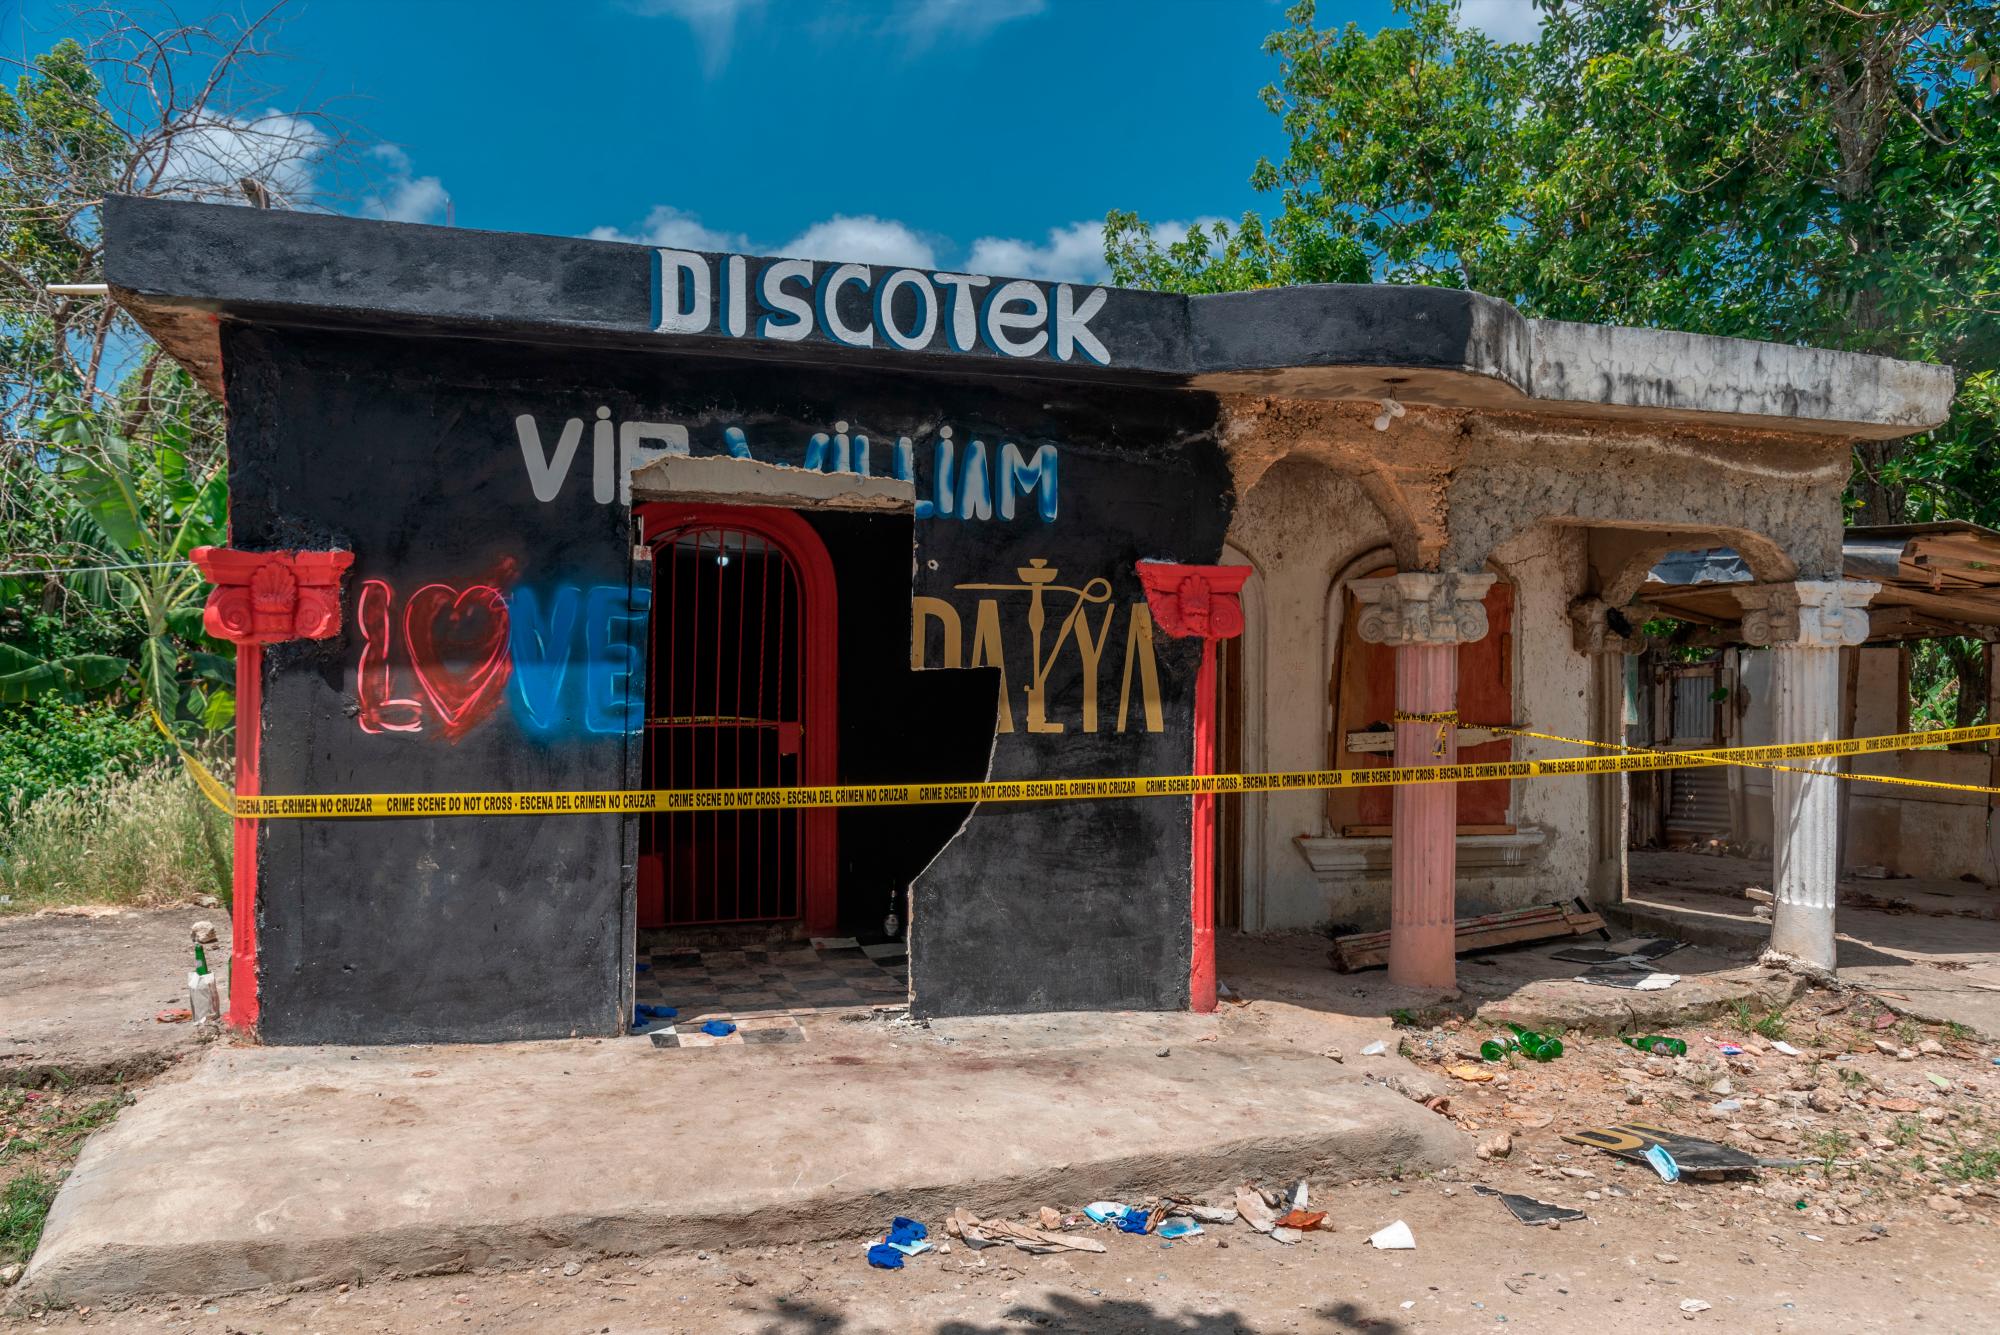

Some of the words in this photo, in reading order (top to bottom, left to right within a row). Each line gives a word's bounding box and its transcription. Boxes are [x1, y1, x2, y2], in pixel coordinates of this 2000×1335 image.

[1866, 740, 1879, 750] CRIME
[1880, 738, 1893, 749] SCENE
[1894, 737, 1900, 747] DO
[1901, 736, 1909, 747] NOT
[1910, 734, 1924, 746] CROSS
[1926, 733, 1942, 744] ESCENA
[1943, 731, 1951, 742] DEL
[1951, 730, 1966, 741] CRIMEN
[1967, 729, 1974, 740] NO
[1974, 728, 1991, 739] CRUZAR
[1729, 750, 1745, 762] SCENE
[1746, 749, 1754, 761] DO
[1755, 748, 1765, 761] NOT
[1766, 747, 1783, 760] CROSS
[1786, 745, 1805, 757] ESCENA
[1806, 744, 1816, 756] DEL
[1817, 743, 1835, 755] CRIMEN
[1835, 743, 1842, 753] NO
[1843, 740, 1860, 753] CRUZAR
[1351, 771, 1370, 784] CRIME
[1371, 770, 1391, 783] SCENE
[1392, 770, 1401, 782] DO
[1402, 769, 1414, 782] NOT
[1415, 768, 1435, 781] CROSS
[1439, 767, 1462, 780] ESCENA
[1463, 766, 1475, 778] DEL
[1476, 765, 1498, 778] CRIMEN
[1499, 764, 1507, 776] NO
[1508, 763, 1531, 776] CRUZAR
[1539, 761, 1556, 774] CRIME
[1557, 760, 1576, 773] SCENE
[1576, 759, 1585, 772] DO
[1586, 759, 1597, 771] NOT
[1598, 757, 1616, 770] CROSS
[1620, 756, 1641, 769] ESCENA
[1642, 755, 1653, 768] DEL
[1653, 753, 1674, 767] CRIMEN
[1674, 753, 1683, 766] NO
[919, 787, 942, 800] CRIME
[944, 787, 967, 800] SCENE
[969, 786, 980, 799] DO
[981, 786, 996, 799] NOT
[997, 785, 1020, 798] CROSS
[1026, 784, 1054, 796] ESCENA
[1055, 783, 1068, 796] DEL
[1069, 783, 1095, 796] CRIMEN
[1097, 782, 1107, 794] NO
[1109, 781, 1136, 794] CRUZAR
[1146, 780, 1166, 793] CRIME
[1168, 779, 1189, 792] SCENE
[1191, 779, 1200, 791] DO
[1202, 778, 1215, 791] NOT
[1216, 777, 1238, 790] CROSS
[1243, 775, 1267, 789] ESCENA
[1269, 776, 1281, 788] DEL
[1282, 774, 1306, 787] CRIMEN
[1307, 774, 1317, 786] NO
[1317, 773, 1342, 786] CRUZAR
[263, 799, 279, 814] DEL
[281, 798, 317, 814] CRIMEN
[320, 798, 333, 813] NO
[336, 798, 372, 812] CRUZAR
[386, 797, 415, 812] CRIME
[417, 796, 446, 812] SCENE
[449, 796, 461, 811] DO
[463, 796, 481, 811] NOT
[483, 795, 513, 811] CROSS
[520, 795, 554, 810] ESCENA
[556, 795, 572, 809] DEL
[574, 794, 606, 809] CRIMEN
[608, 794, 621, 809] NO
[623, 794, 656, 808] CRUZAR
[668, 793, 693, 807] CRIME
[695, 792, 721, 807] SCENE
[724, 792, 735, 806] DO
[737, 791, 753, 806] NOT
[755, 791, 781, 806] CROSS
[787, 790, 817, 805] ESCENA
[819, 790, 833, 804] DEL
[835, 789, 864, 803] CRIMEN
[866, 789, 877, 802] NO
[878, 788, 908, 801] CRUZAR
